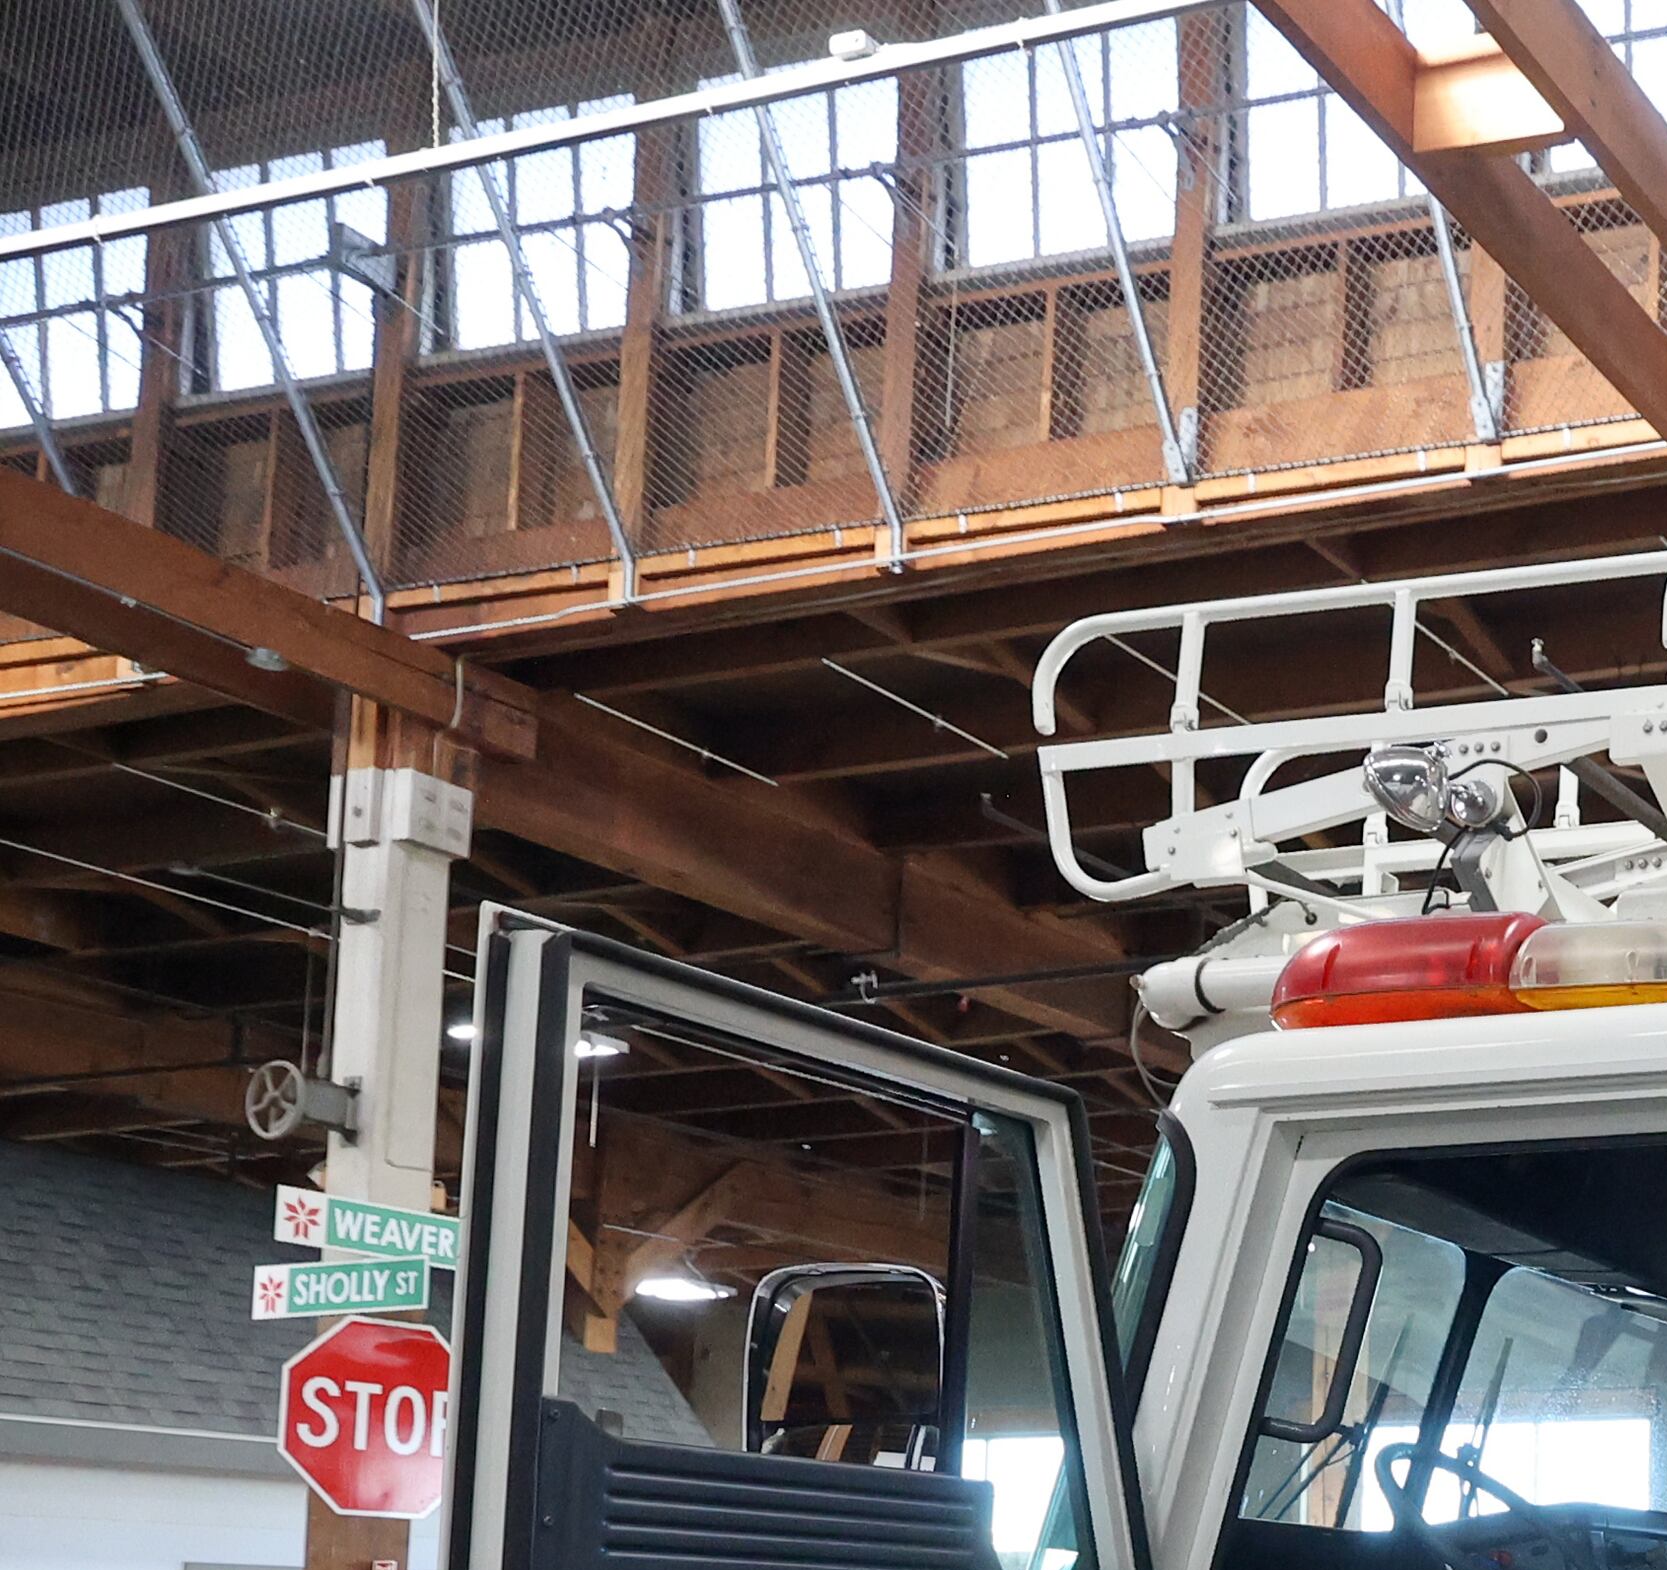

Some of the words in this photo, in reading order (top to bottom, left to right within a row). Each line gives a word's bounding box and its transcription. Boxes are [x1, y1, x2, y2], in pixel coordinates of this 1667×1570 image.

[334, 1207, 456, 1258] WEAVER
[293, 1269, 391, 1305] SHOLLY
[395, 1271, 418, 1295] ST
